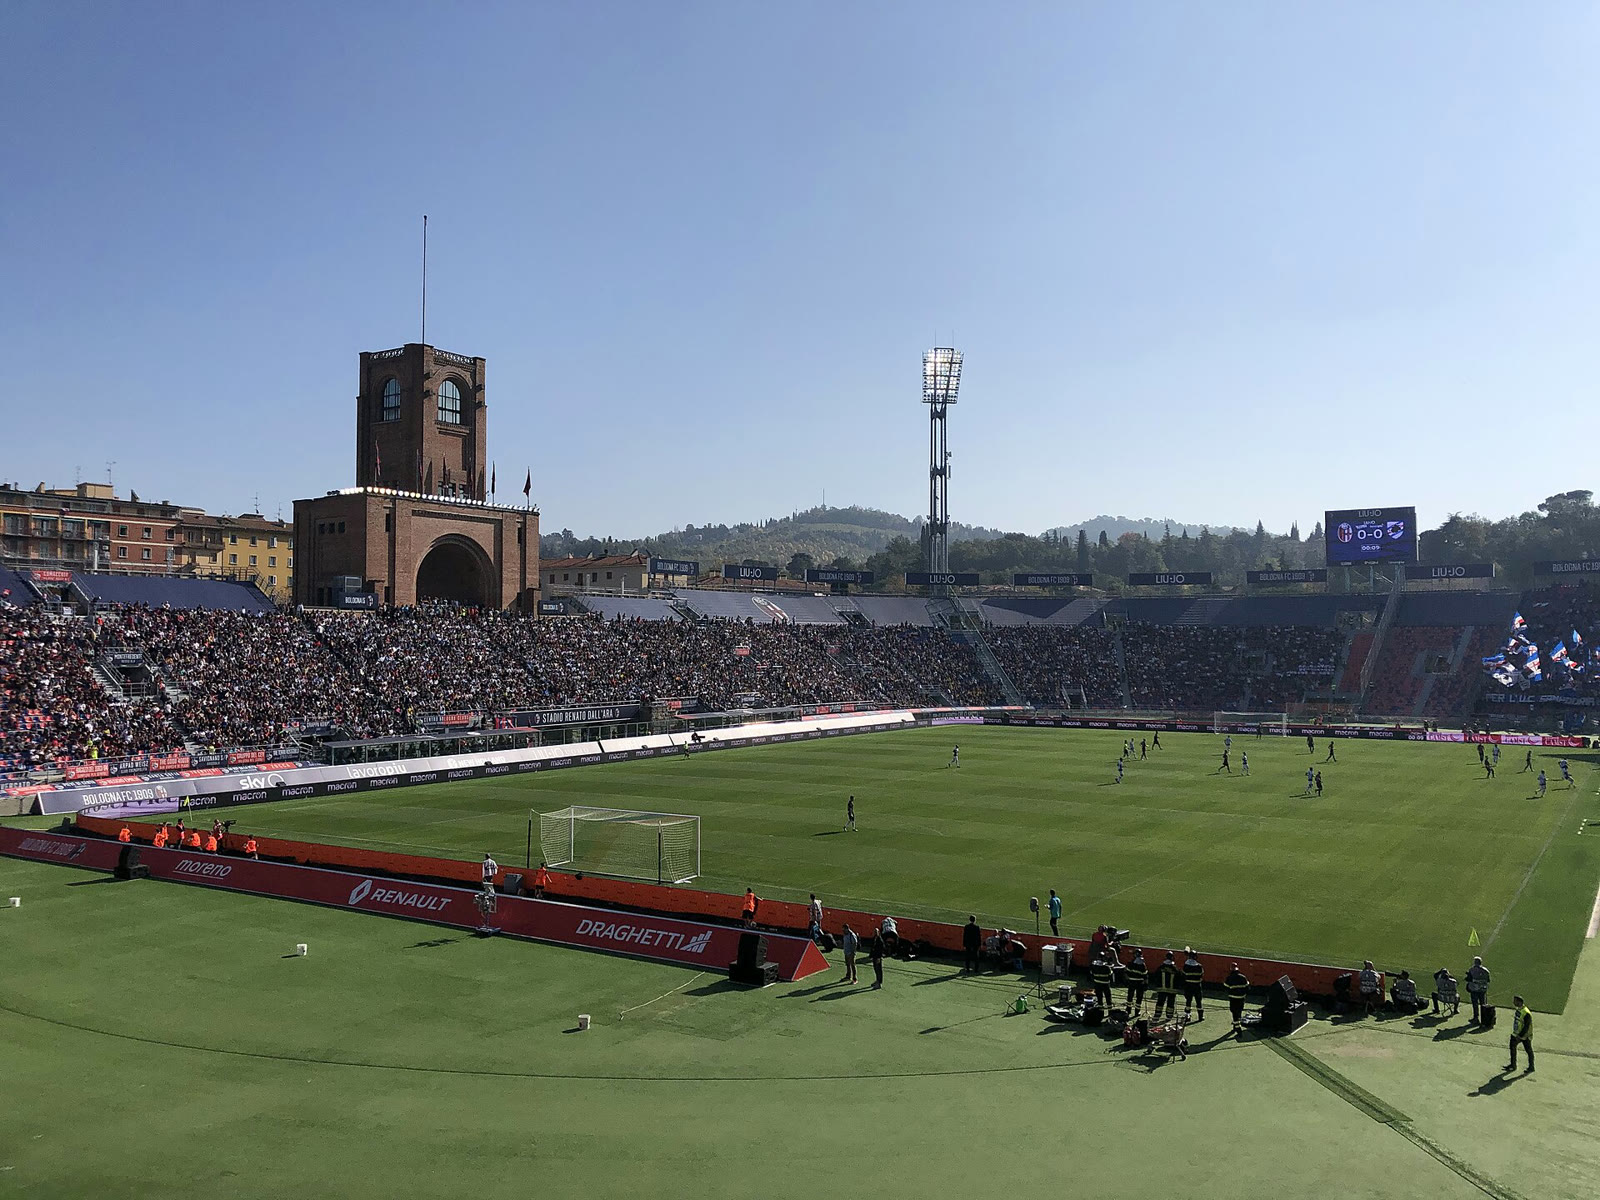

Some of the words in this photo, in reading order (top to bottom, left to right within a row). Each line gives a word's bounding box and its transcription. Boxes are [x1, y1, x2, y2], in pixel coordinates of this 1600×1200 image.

[657, 561, 674, 571] BOLOGNA
[1552, 563, 1582, 572] BOLOGNA
[1582, 562, 1591, 571] FC
[818, 572, 838, 581] BOLOGNA
[1028, 576, 1050, 584] BOLOGNA
[1051, 576, 1057, 584] FC
[1057, 576, 1070, 584] 1909
[1259, 572, 1283, 581] BOLOGNA
[1284, 572, 1291, 580] FC
[542, 712, 564, 723] STADIO
[564, 710, 586, 722] RENATO
[588, 708, 613, 720] DALL'ARA
[233, 791, 267, 802] macron
[282, 786, 314, 797] macron
[327, 782, 357, 791] macron
[370, 777, 398, 787] macron
[410, 773, 437, 782] macron
[448, 769, 473, 778] macron
[485, 765, 509, 774] macron
[519, 762, 542, 770] macron
[550, 758, 572, 766] macron
[580, 755, 600, 763] macron
[239, 775, 265, 790] sky
[82, 793, 121, 806] BOLOGNA
[121, 790, 133, 802] FC
[132, 788, 154, 800] 1909
[175, 858, 232, 876] moreno
[370, 888, 452, 911] RENAULT
[576, 919, 685, 950] DRAGHETTI
